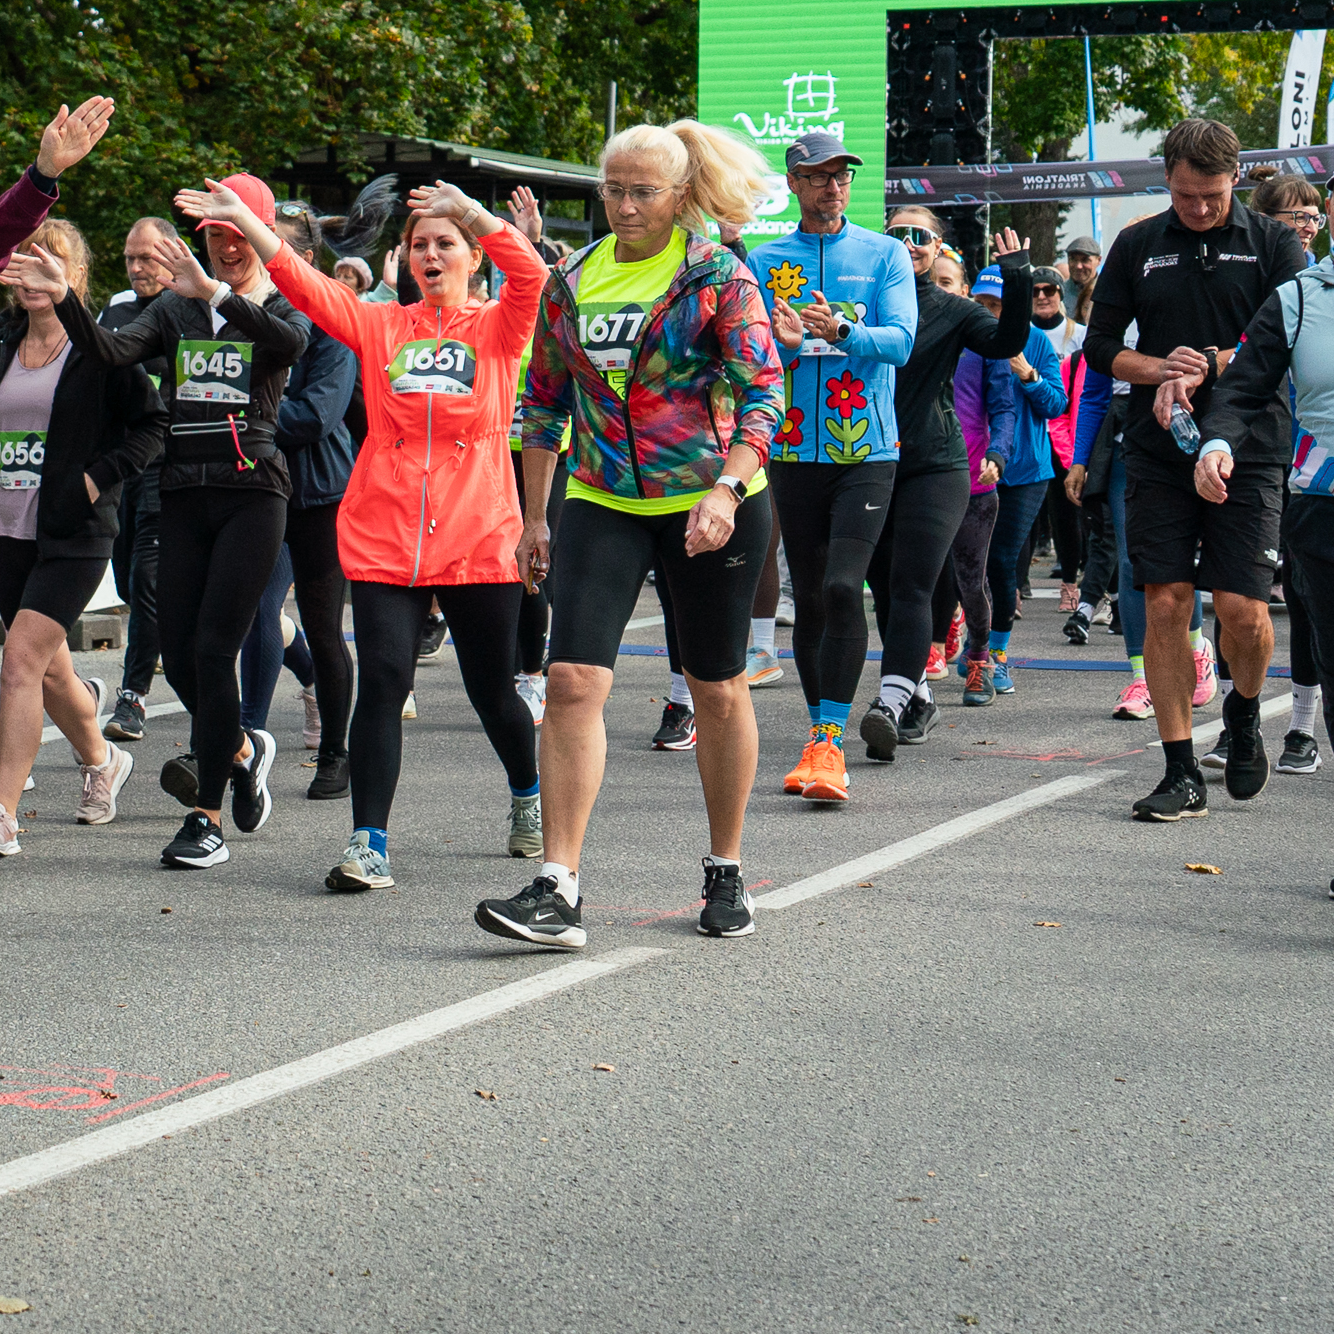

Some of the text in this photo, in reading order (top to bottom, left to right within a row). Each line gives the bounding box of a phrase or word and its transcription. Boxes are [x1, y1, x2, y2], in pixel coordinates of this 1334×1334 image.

[1290, 70, 1306, 148] LONI
[578, 312, 646, 343] 1677
[183, 350, 243, 378] 1645
[404, 347, 466, 371] 1661
